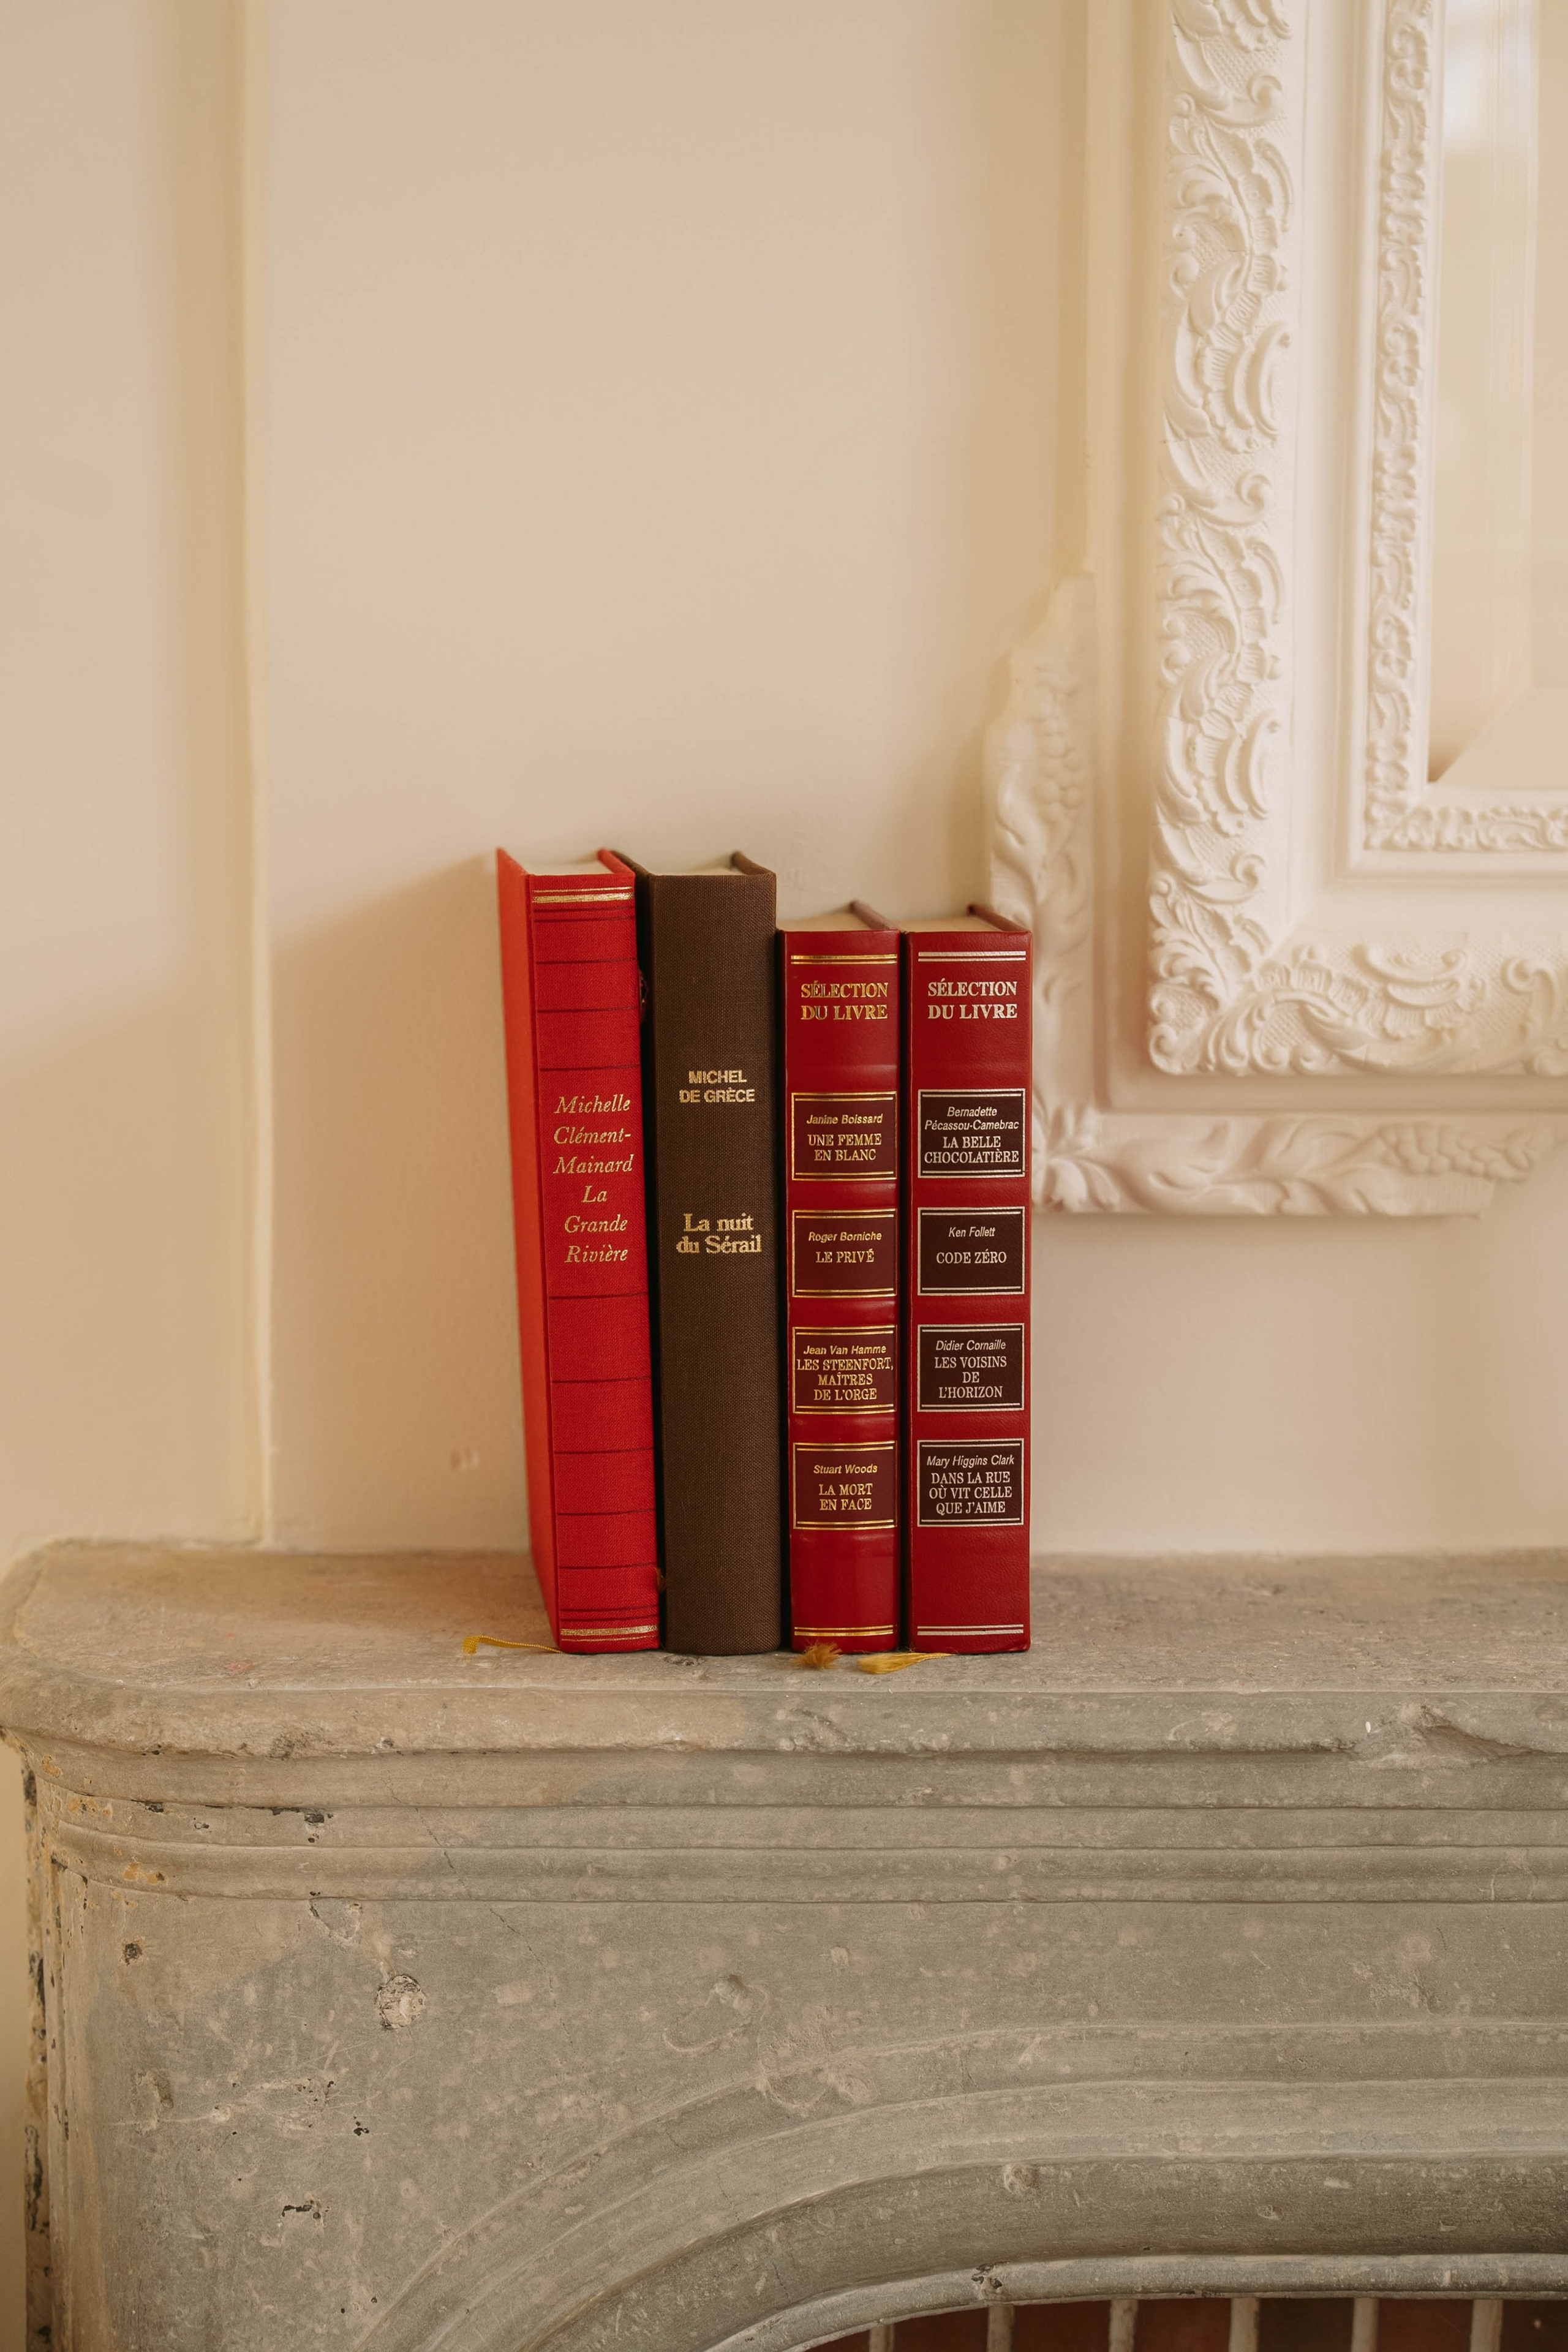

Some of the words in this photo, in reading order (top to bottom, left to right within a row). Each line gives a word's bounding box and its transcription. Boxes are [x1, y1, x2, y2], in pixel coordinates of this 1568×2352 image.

[801, 980, 888, 998] SÉLECTION
[928, 978, 1017, 997] SÉLECTION
[801, 1006, 828, 1020] DU
[833, 1005, 888, 1020] LIVRE
[928, 1005, 954, 1019] DU
[959, 1004, 1017, 1019] LIVRE
[688, 1070, 747, 1084] MICHEL
[679, 1089, 701, 1102] DE
[704, 1087, 755, 1102] GRÈCE
[554, 1094, 630, 1114] Michelle
[947, 1107, 997, 1117] Bernadette
[806, 1115, 838, 1125] Janine
[842, 1114, 883, 1124] Boissard
[925, 1120, 1019, 1131] Pécassou-Camebrac
[554, 1126, 631, 1144] Clément-
[808, 1134, 834, 1146] UNE
[838, 1133, 882, 1145] FEMME
[943, 1137, 958, 1148] LA
[962, 1136, 1001, 1148] BELLE
[814, 1150, 832, 1161] EN
[835, 1149, 876, 1161] BLANC
[924, 1149, 1019, 1163] CHOCOLATIÈRE
[552, 1154, 634, 1174] Mainard
[581, 1185, 607, 1202] La
[564, 1213, 628, 1233] Grande
[683, 1213, 710, 1232] La
[717, 1212, 754, 1231] nuit
[809, 1232, 837, 1243] Roger
[840, 1231, 882, 1241] Borniche
[948, 1227, 966, 1237] Ken
[969, 1227, 995, 1237] Follett
[676, 1235, 700, 1254] du
[705, 1234, 762, 1254] Sérail
[564, 1244, 628, 1263] Rivière
[816, 1252, 832, 1263] LE
[836, 1248, 874, 1263] PRIVÉ
[937, 1252, 971, 1264] CODE
[974, 1249, 1007, 1264] ZÉRO
[804, 1346, 827, 1355] Jean
[830, 1346, 848, 1354] Van
[851, 1345, 886, 1354] Hamme
[936, 1340, 963, 1351] Didier
[967, 1340, 1006, 1350] Cornaille
[797, 1359, 819, 1371] LES
[823, 1357, 893, 1371] STEENFORT,
[935, 1357, 957, 1368] LES
[960, 1356, 1007, 1368] VOISINS
[818, 1372, 873, 1385] MAÎTRES
[962, 1371, 979, 1383] DE
[813, 1389, 831, 1401] DE
[835, 1388, 877, 1401] L'ORGE
[939, 1386, 1003, 1398] L'HORIZON
[927, 1456, 949, 1469] Mary
[952, 1455, 987, 1468] Higgins
[991, 1455, 1014, 1465] Clark
[813, 1464, 842, 1474] Stuart
[845, 1464, 878, 1474] Woods
[931, 1472, 963, 1484] DANS
[967, 1472, 982, 1483] LA
[986, 1471, 1010, 1483] RUE
[819, 1484, 835, 1496] LA
[839, 1483, 873, 1495] MORT
[929, 1485, 946, 1499] OÙ
[951, 1487, 970, 1499] VIT
[974, 1487, 1012, 1498] CELLE
[820, 1499, 837, 1510] EN
[841, 1498, 872, 1510] FACE
[936, 1502, 962, 1515] QUE
[965, 1502, 1005, 1513] J'AIME
